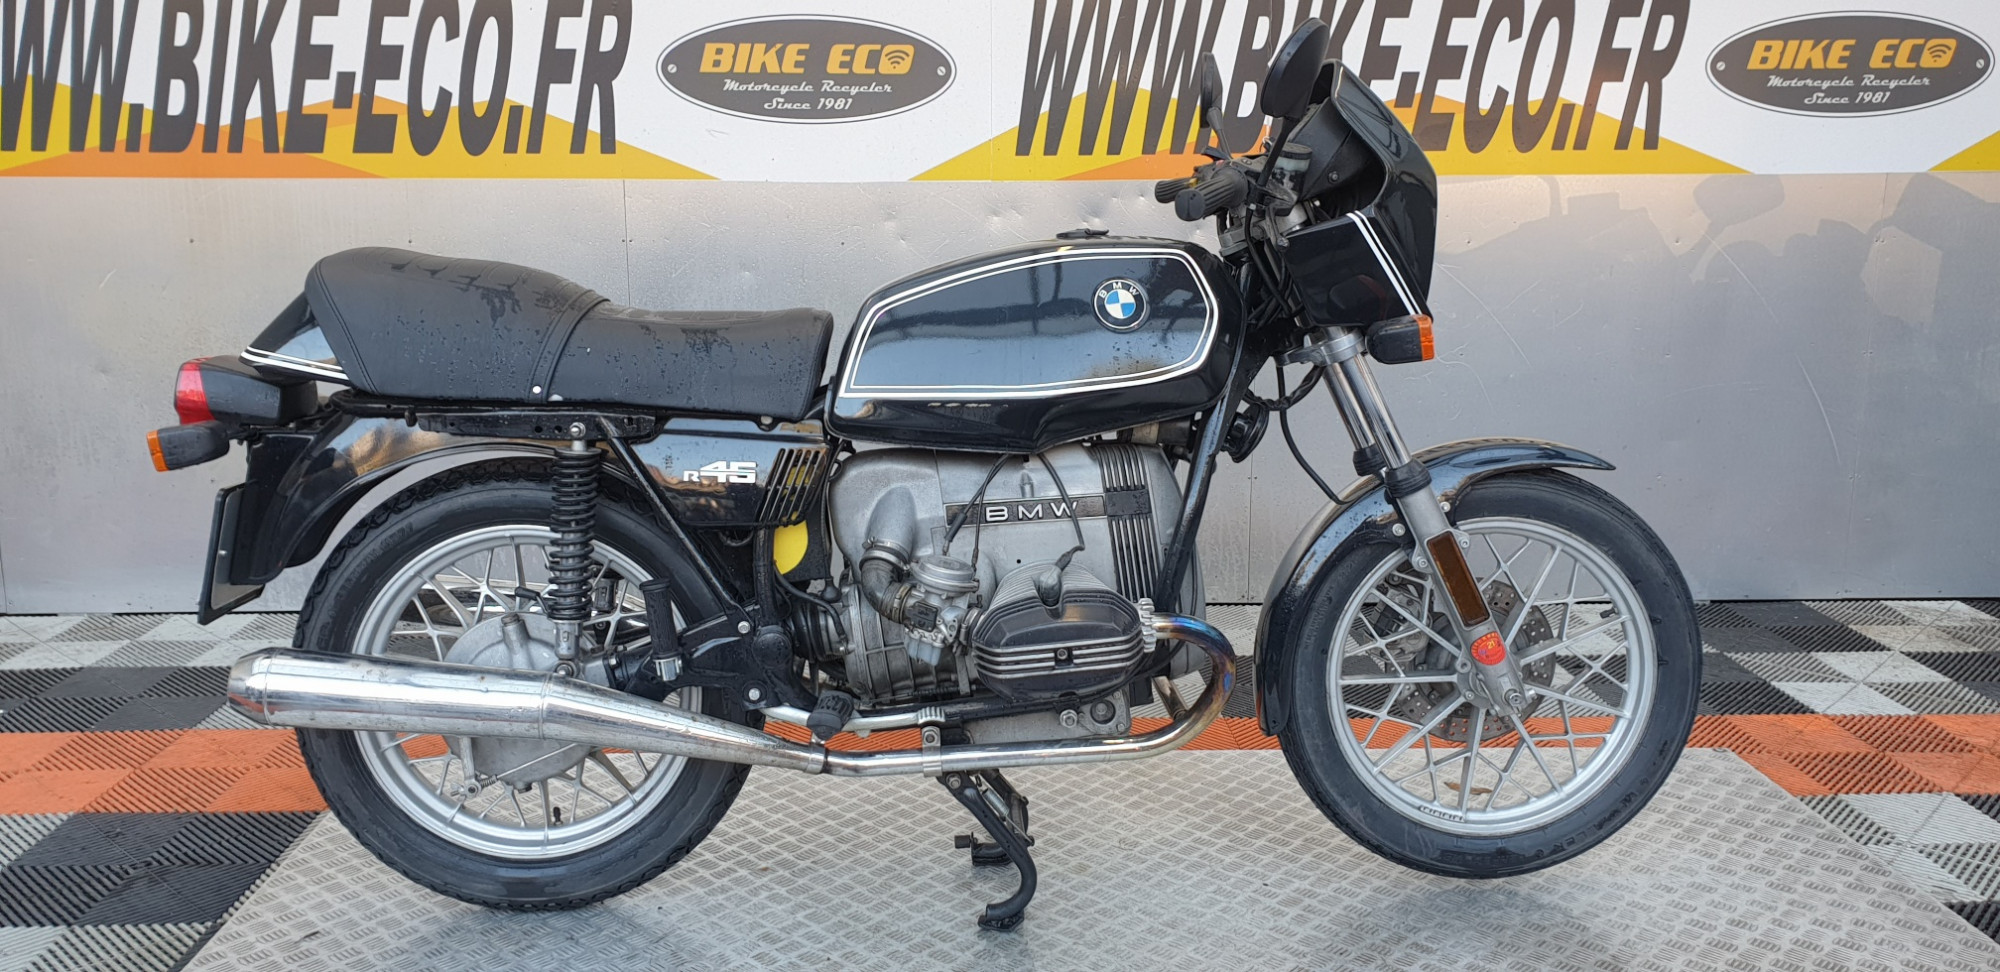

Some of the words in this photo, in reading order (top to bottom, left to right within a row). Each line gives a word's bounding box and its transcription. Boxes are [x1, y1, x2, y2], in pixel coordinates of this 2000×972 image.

[699, 42, 810, 73] BIKE
[826, 43, 915, 75] ECO
[1746, 39, 1857, 70] BIKE
[1868, 38, 1958, 69] ECO
[722, 78, 815, 95] Motorcycle
[820, 79, 893, 96] Recycler
[1766, 74, 1855, 90] Motorcycle
[1861, 74, 1931, 89] Recycler
[763, 97, 812, 110] Since
[816, 97, 853, 110] 1981
[1803, 92, 1850, 105] Since
[1854, 91, 1891, 104] 1981
[1098, 281, 1140, 299] BMW
[985, 501, 1078, 522] BMW
